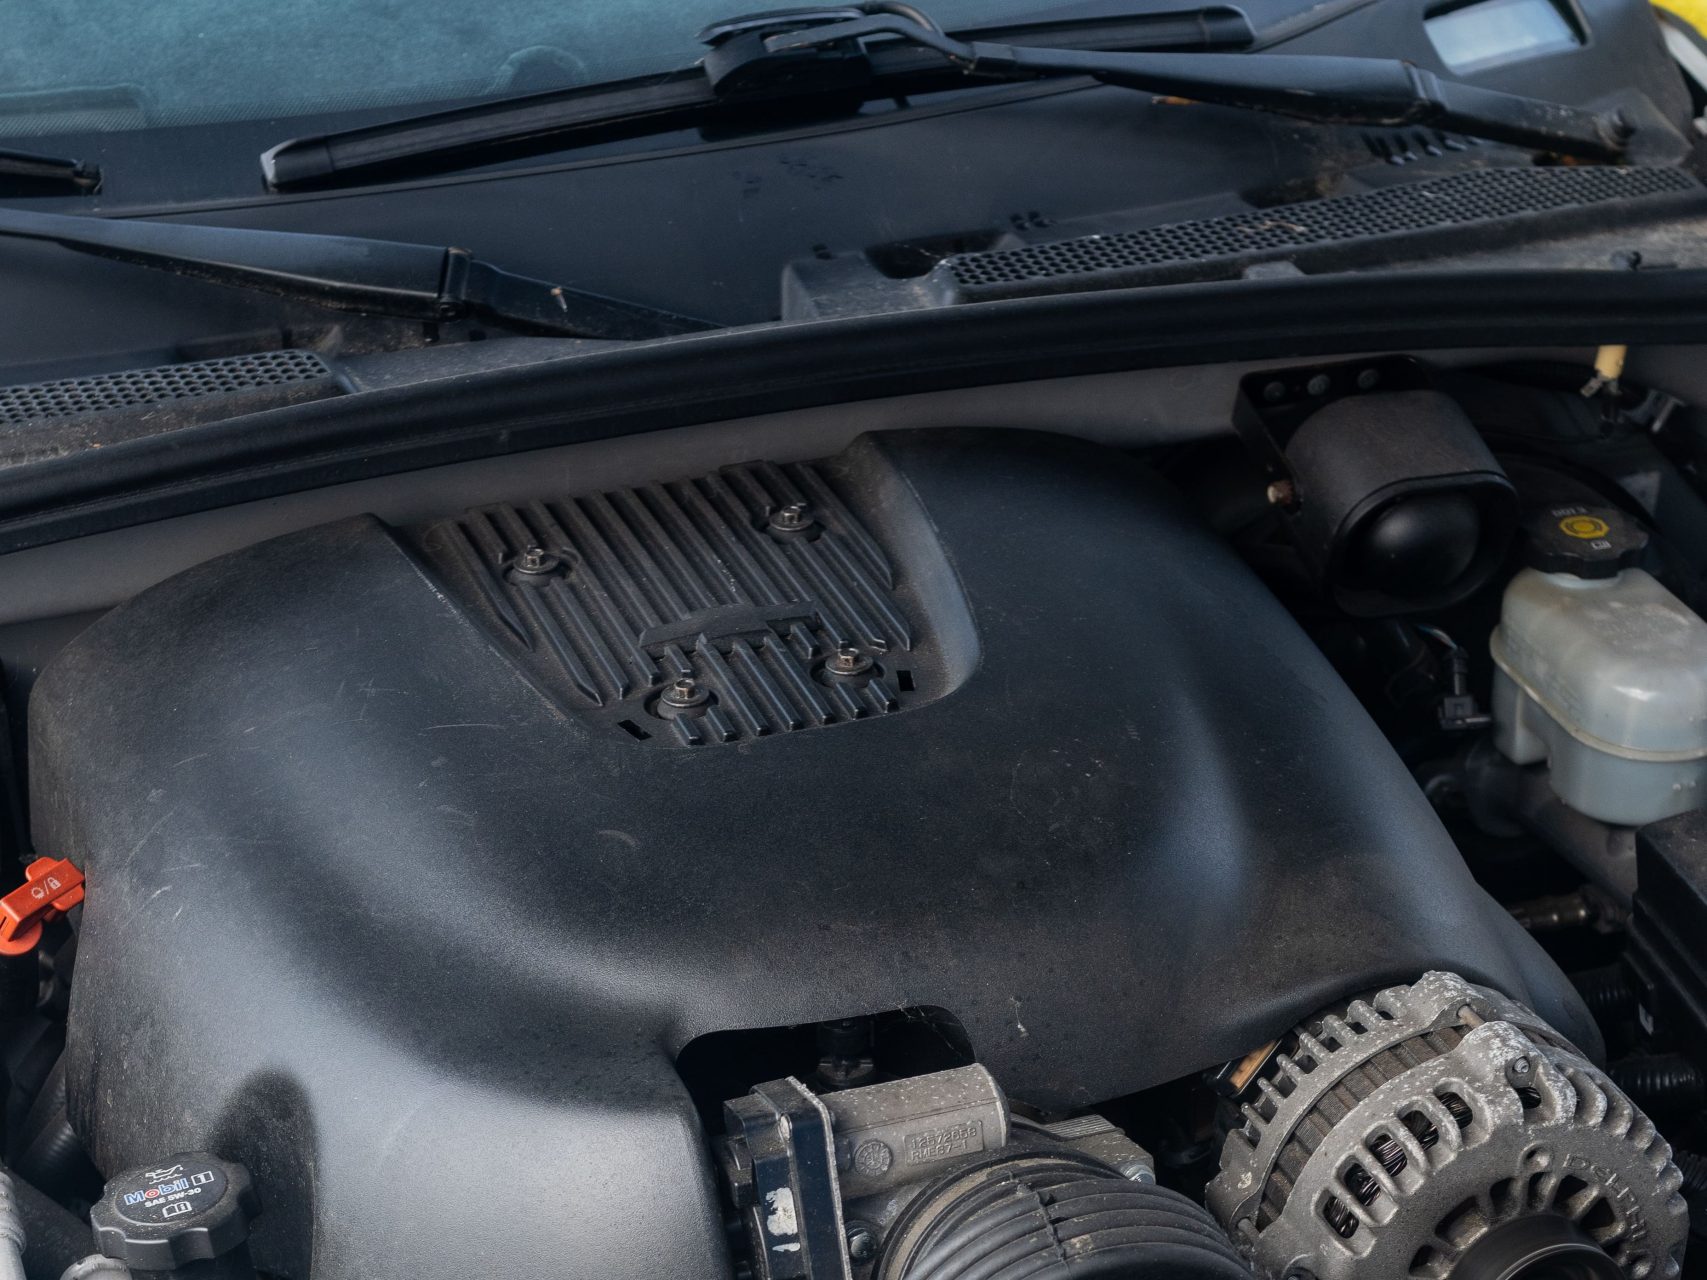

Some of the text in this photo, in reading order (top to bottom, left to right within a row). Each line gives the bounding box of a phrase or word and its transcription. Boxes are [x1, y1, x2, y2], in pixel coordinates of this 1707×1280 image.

[124, 1178, 190, 1206] Mobil
[144, 1187, 202, 1208] SAE 5W-30
